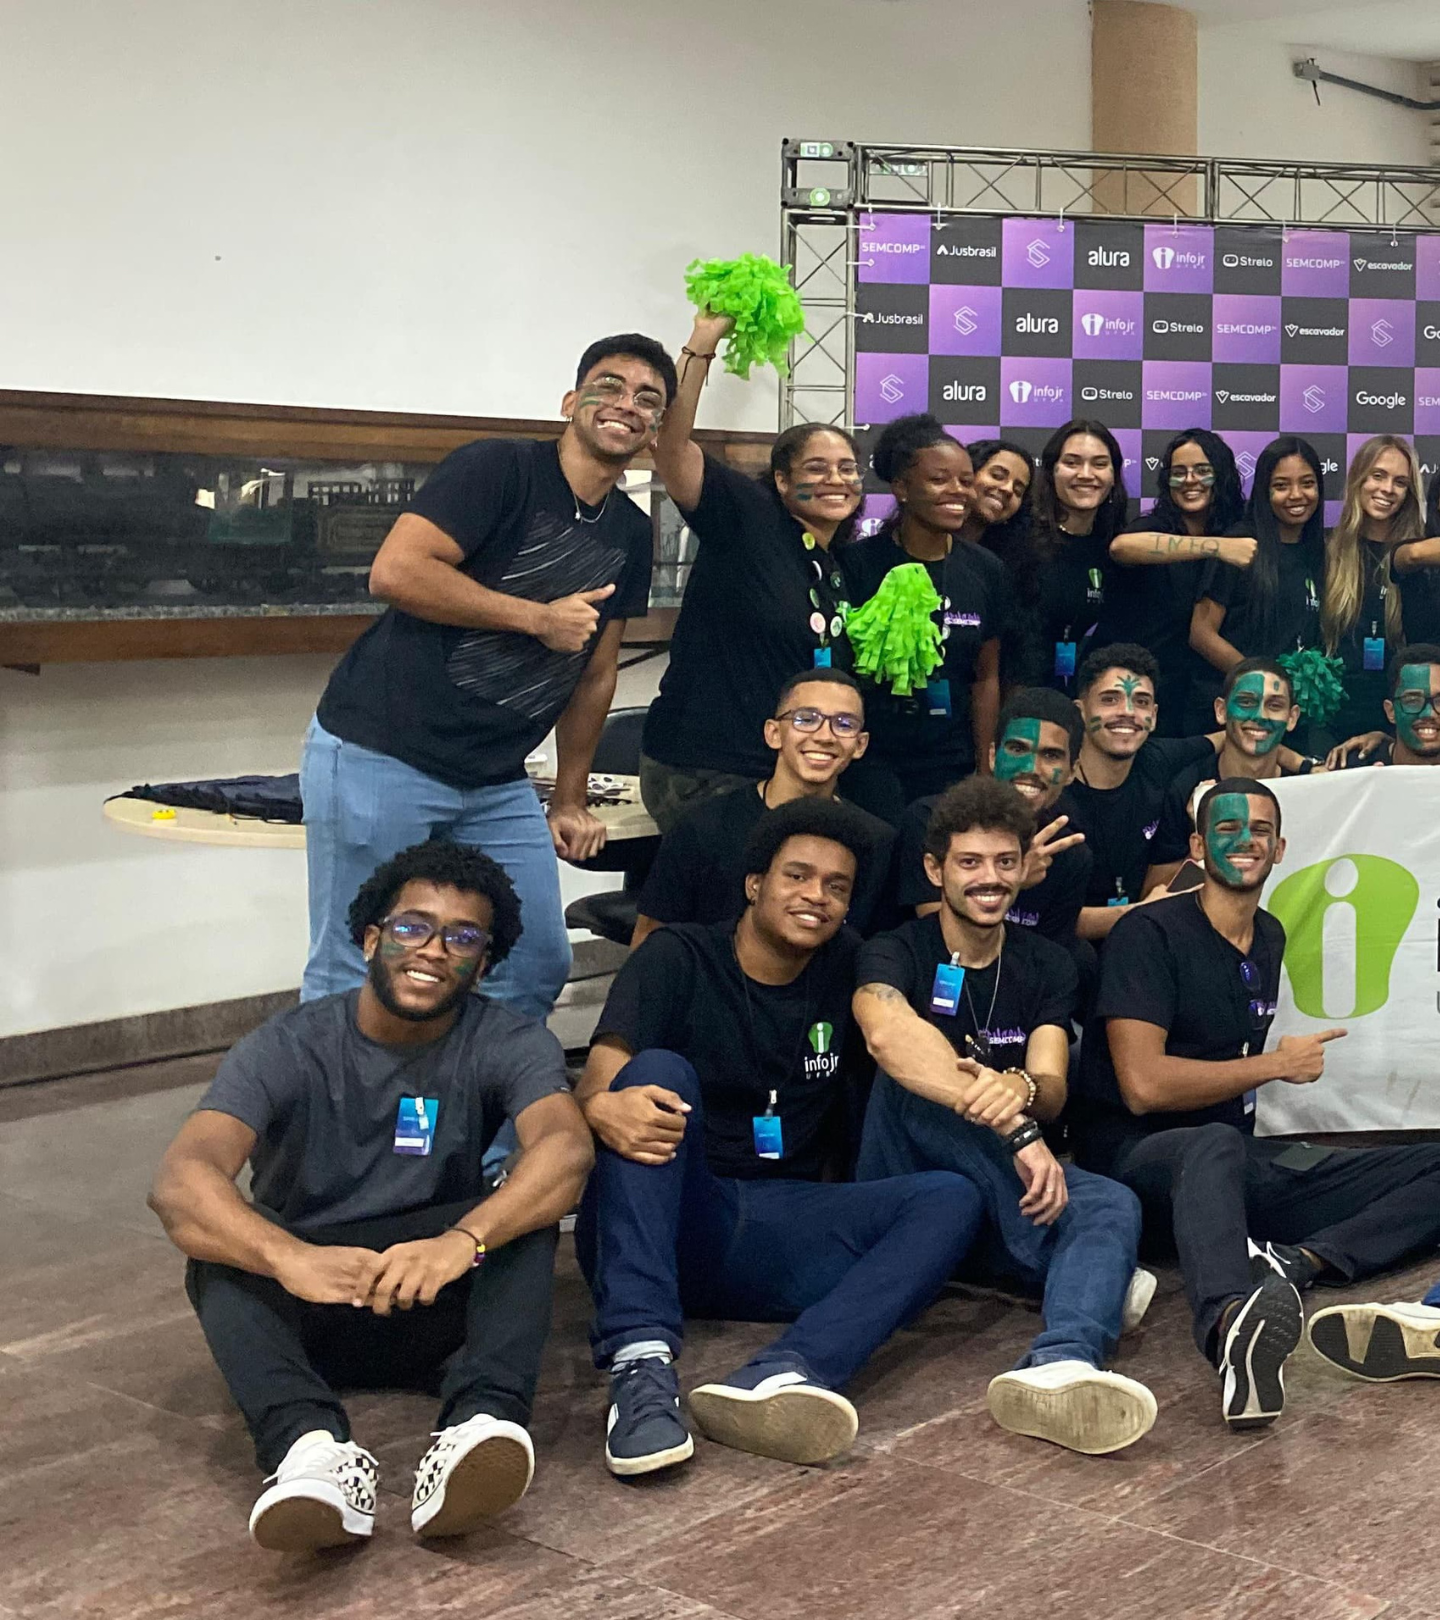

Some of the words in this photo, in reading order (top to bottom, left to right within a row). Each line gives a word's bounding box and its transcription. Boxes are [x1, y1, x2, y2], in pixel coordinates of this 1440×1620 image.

[949, 245, 997, 258] Jusbrasil
[1088, 245, 1130, 267] alura
[1367, 261, 1413, 271] escavador
[875, 312, 923, 325] Jusbrasil
[1015, 312, 1059, 334] alura
[1299, 327, 1345, 337] escavador
[942, 380, 986, 401] alura
[1229, 392, 1277, 403] escavador
[1355, 390, 1406, 409] Google
